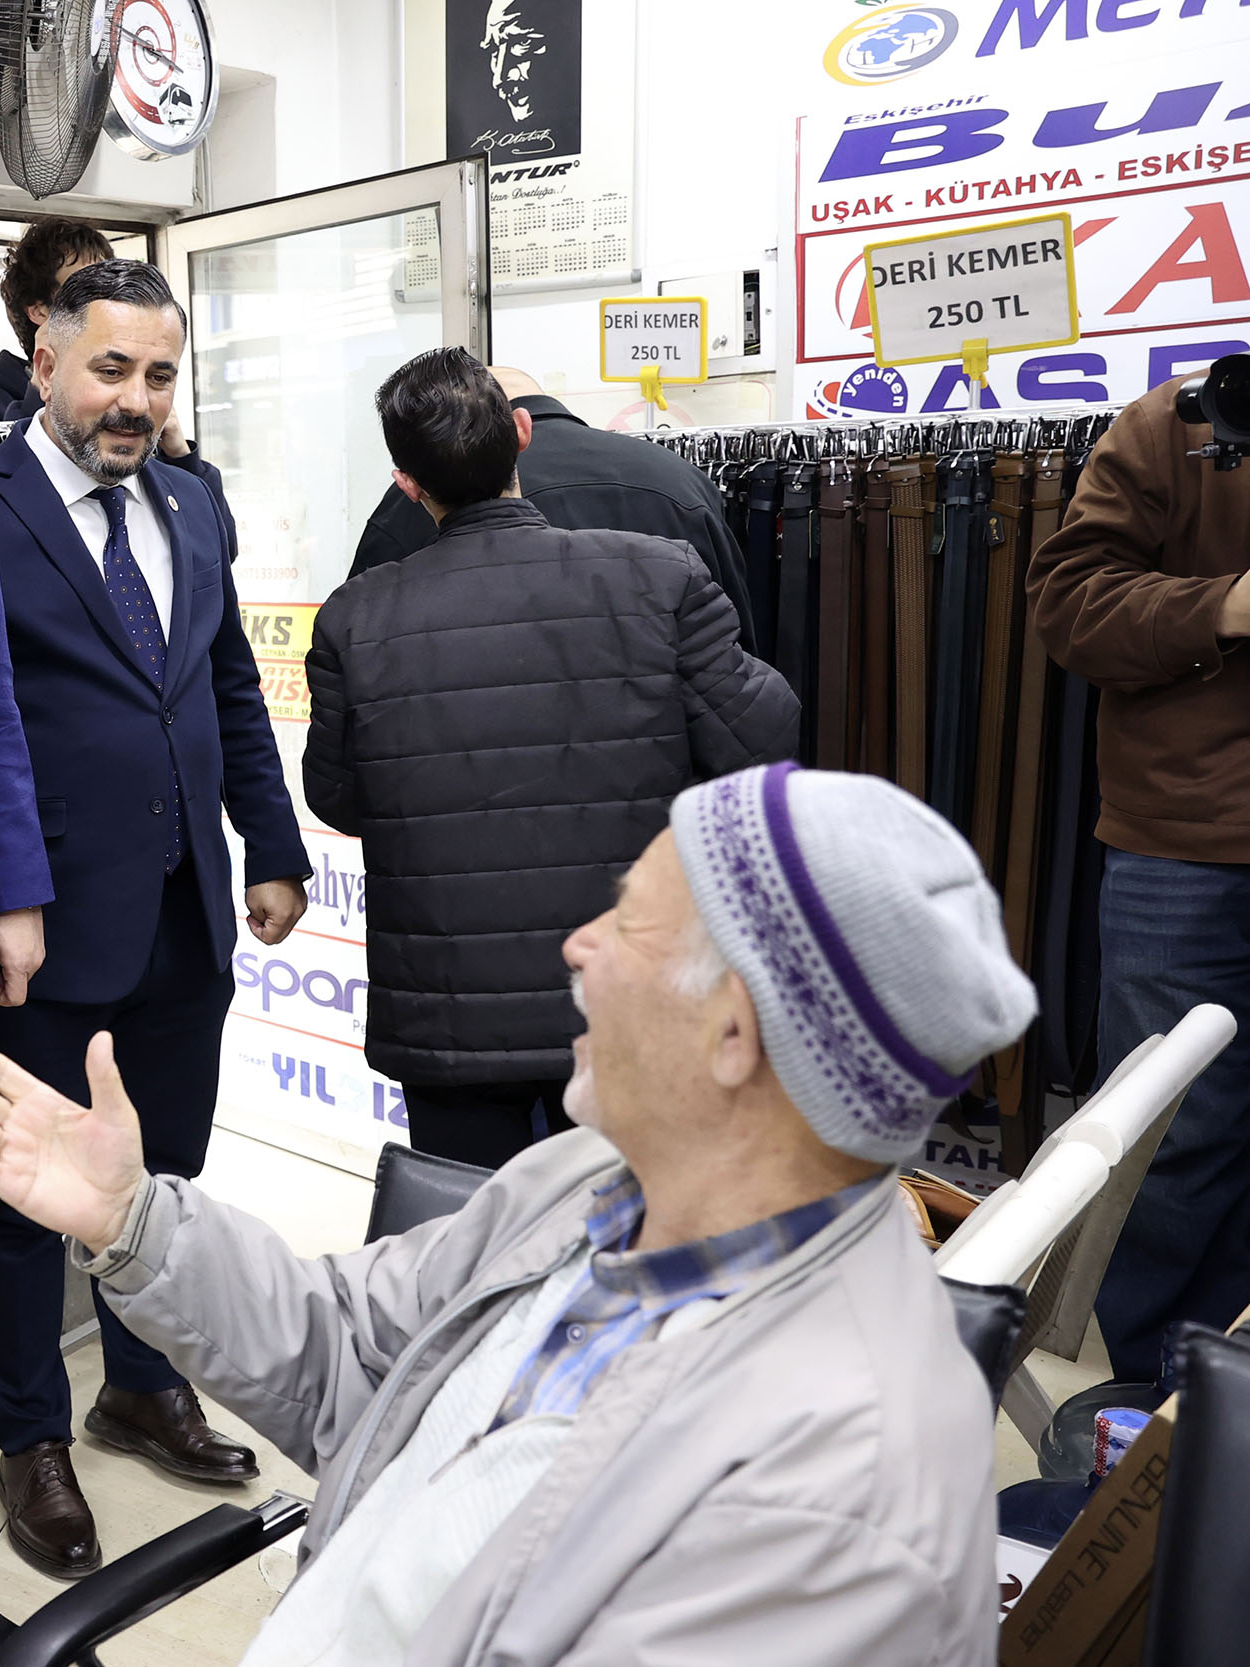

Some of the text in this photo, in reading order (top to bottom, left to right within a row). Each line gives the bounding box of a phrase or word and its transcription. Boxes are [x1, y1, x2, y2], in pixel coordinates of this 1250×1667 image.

[844, 94, 989, 126] Eskişehir
[818, 81, 1250, 184] Bu
[811, 193, 895, 224] UŞAK
[926, 168, 1083, 208] KÜTAHYA
[873, 238, 1063, 289] DERİ KEMER
[605, 310, 699, 329] DERİ KEMER
[927, 294, 1030, 330] 250 TL
[631, 345, 681, 360] 250 TL
[843, 367, 905, 408] yeniden
[292, 650, 307, 658] OSM
